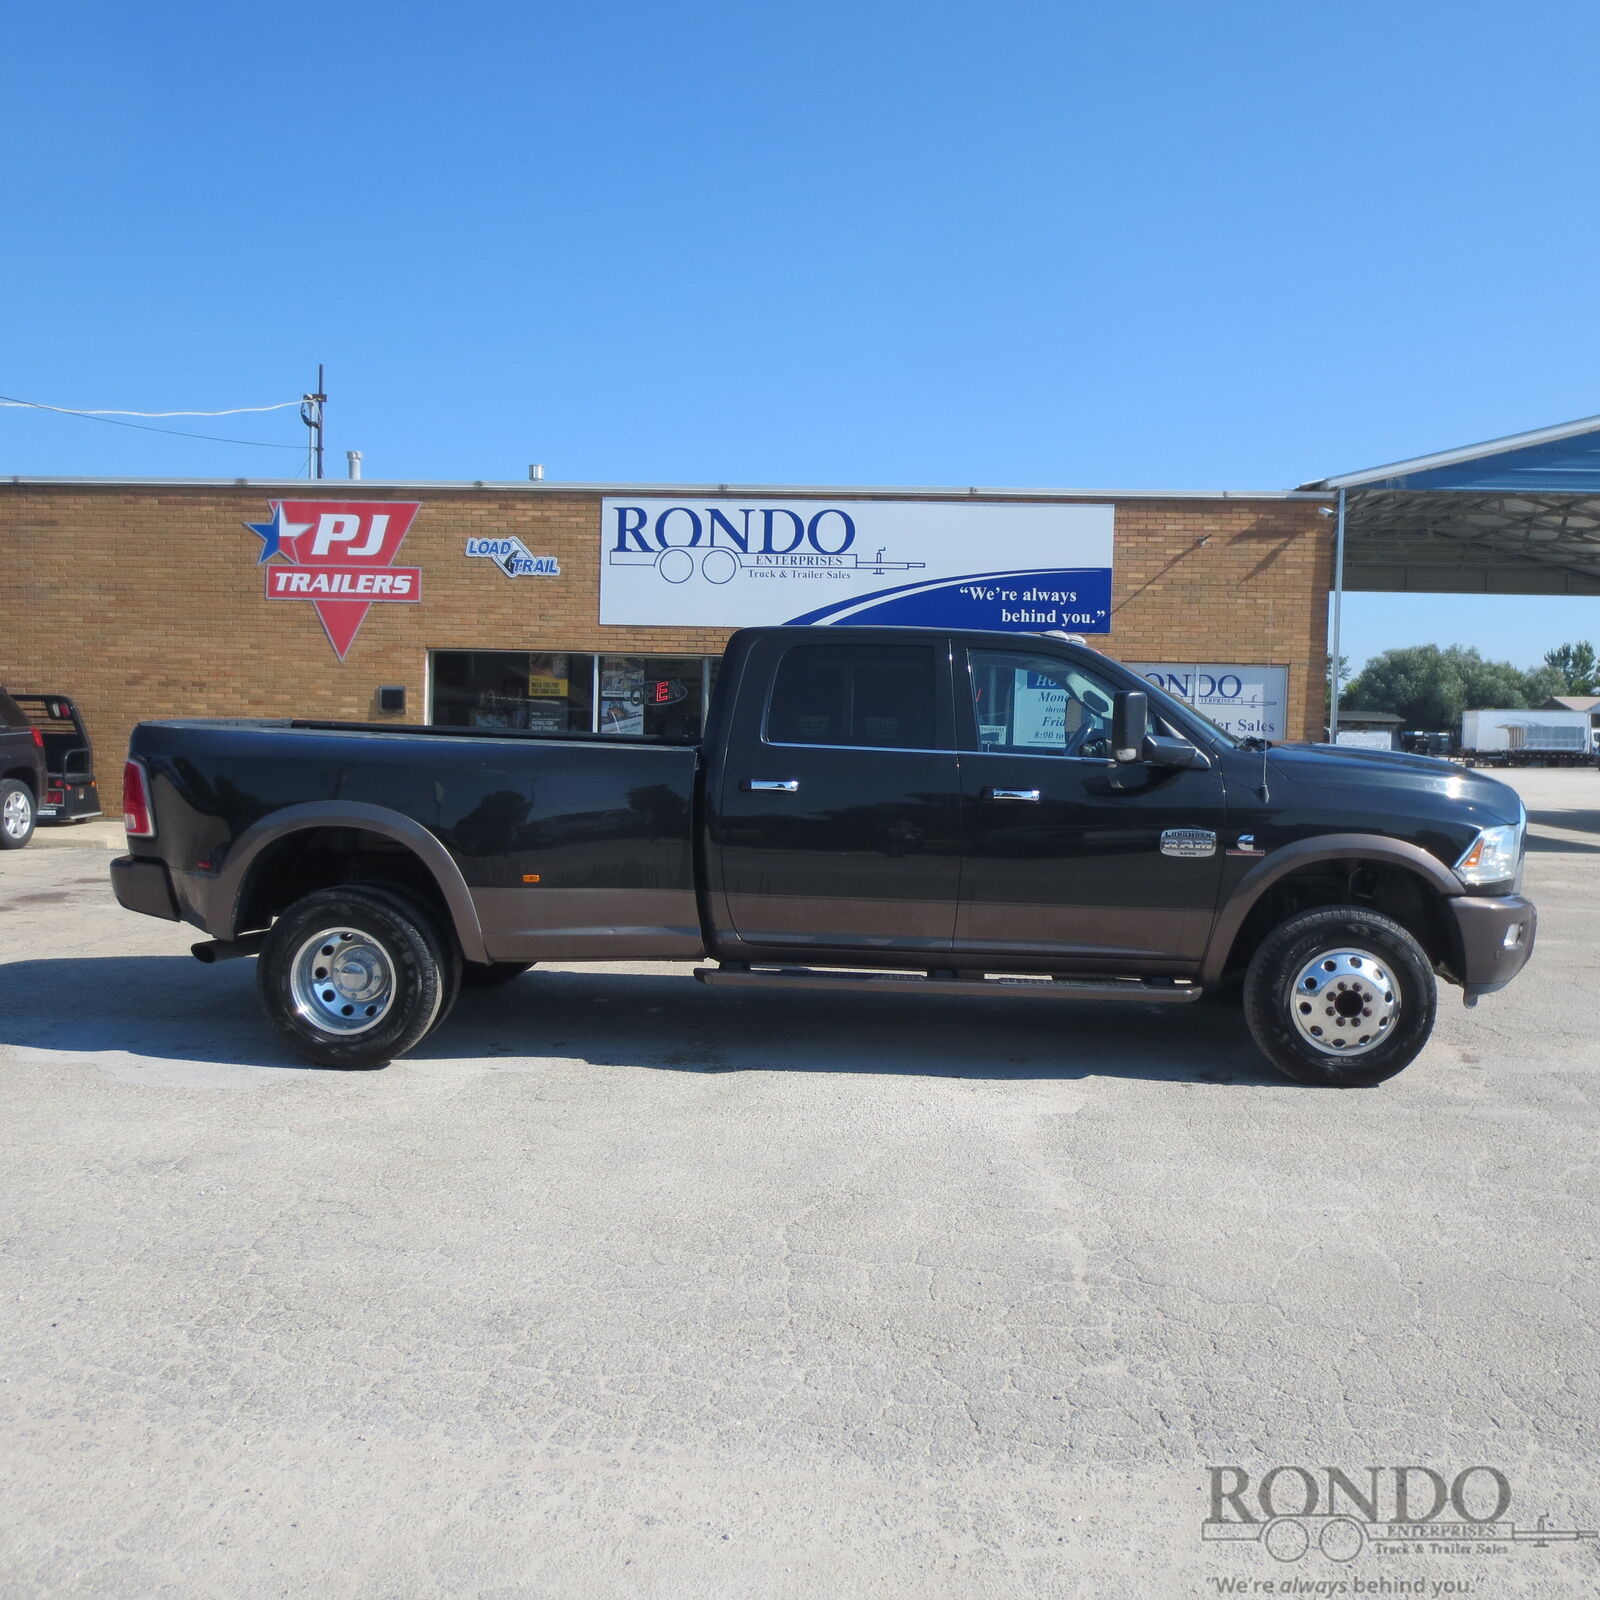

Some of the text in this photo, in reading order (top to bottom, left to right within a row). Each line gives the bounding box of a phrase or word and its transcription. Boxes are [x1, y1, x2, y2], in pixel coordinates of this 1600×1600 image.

[311, 513, 390, 556] PJ
[612, 507, 856, 555] RONDO
[468, 541, 511, 554] LOAD
[513, 559, 557, 572] TRAIL
[756, 555, 843, 566] ENTERPRISES
[748, 569, 851, 579] Truck & Trailer Sales
[275, 573, 412, 594] TRAILERS
[1022, 588, 1077, 605] always
[1001, 609, 1056, 623] behind
[1237, 719, 1275, 732] Sales
